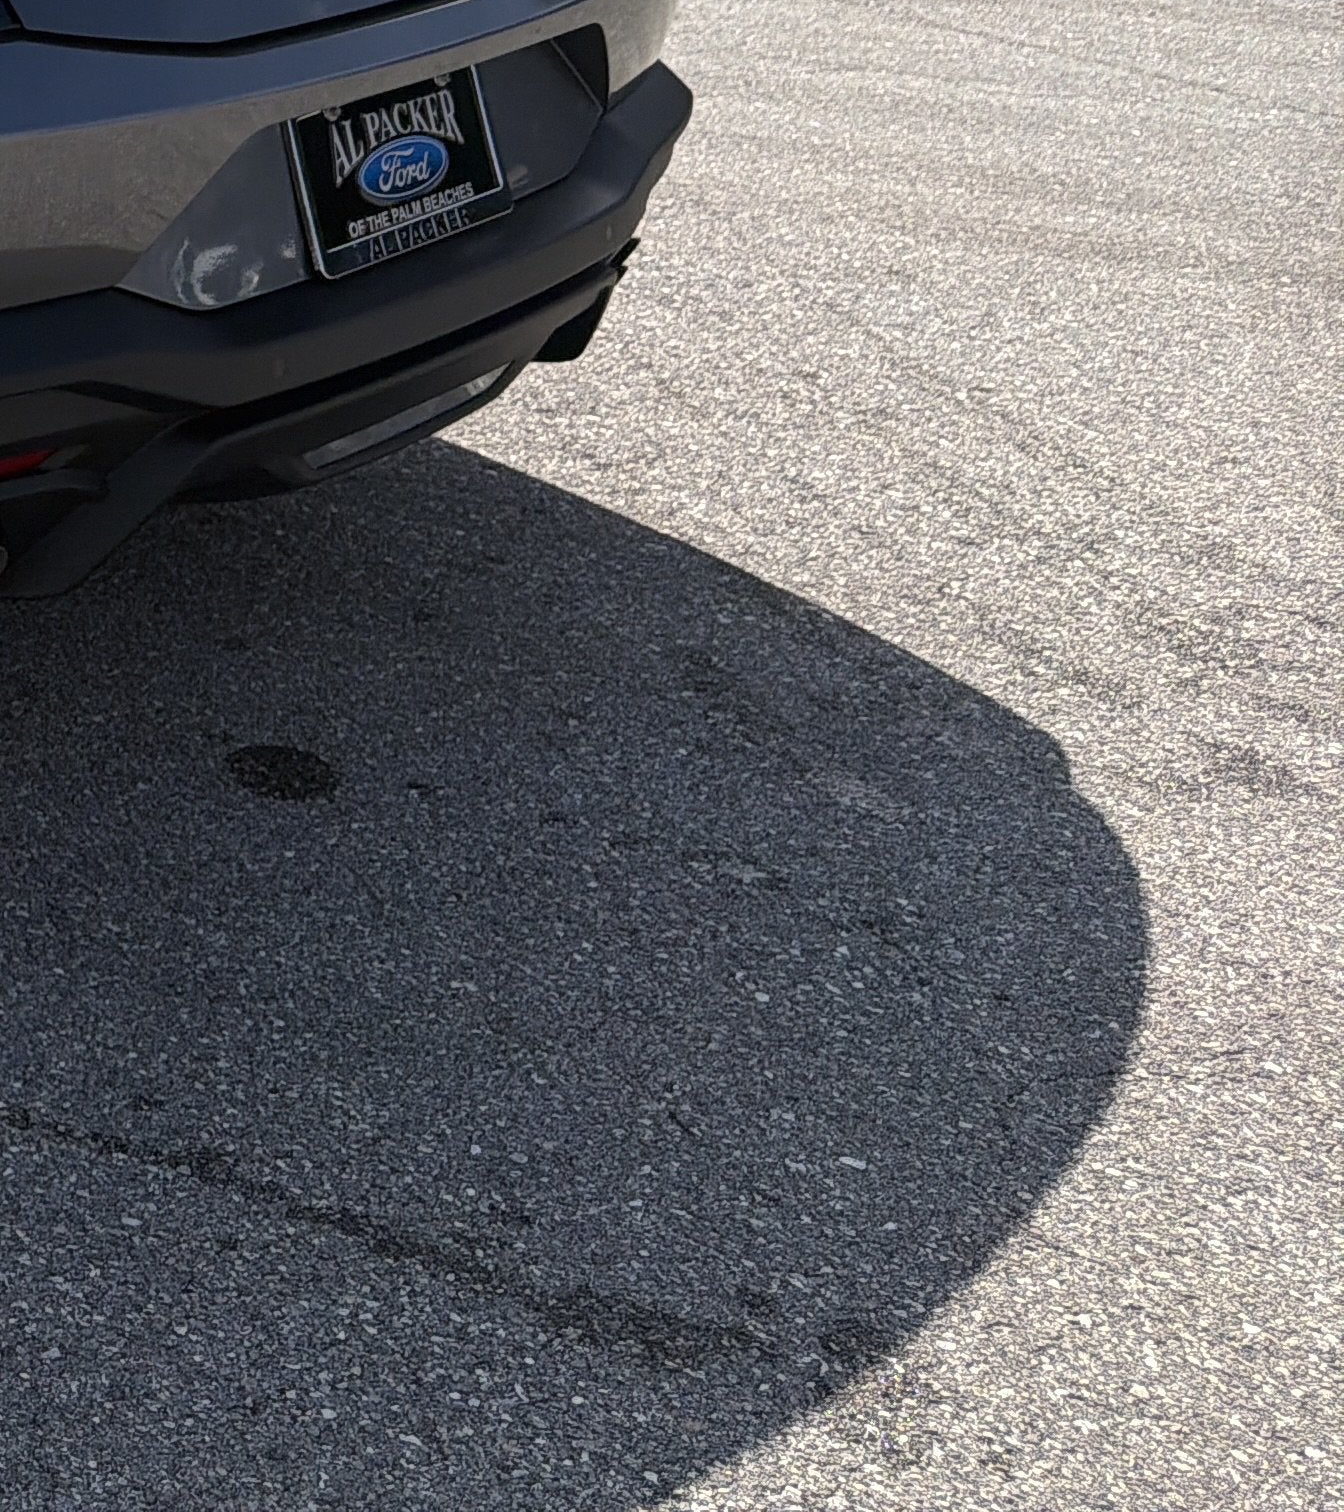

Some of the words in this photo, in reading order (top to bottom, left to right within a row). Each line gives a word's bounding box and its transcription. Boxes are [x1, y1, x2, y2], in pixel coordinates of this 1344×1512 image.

[330, 119, 365, 188] AL
[360, 89, 465, 149] PACKER
[378, 147, 431, 192] Ford
[348, 219, 366, 238] OF
[365, 210, 392, 233] THE
[390, 199, 423, 224] PALM
[422, 181, 475, 213] BEACHES
